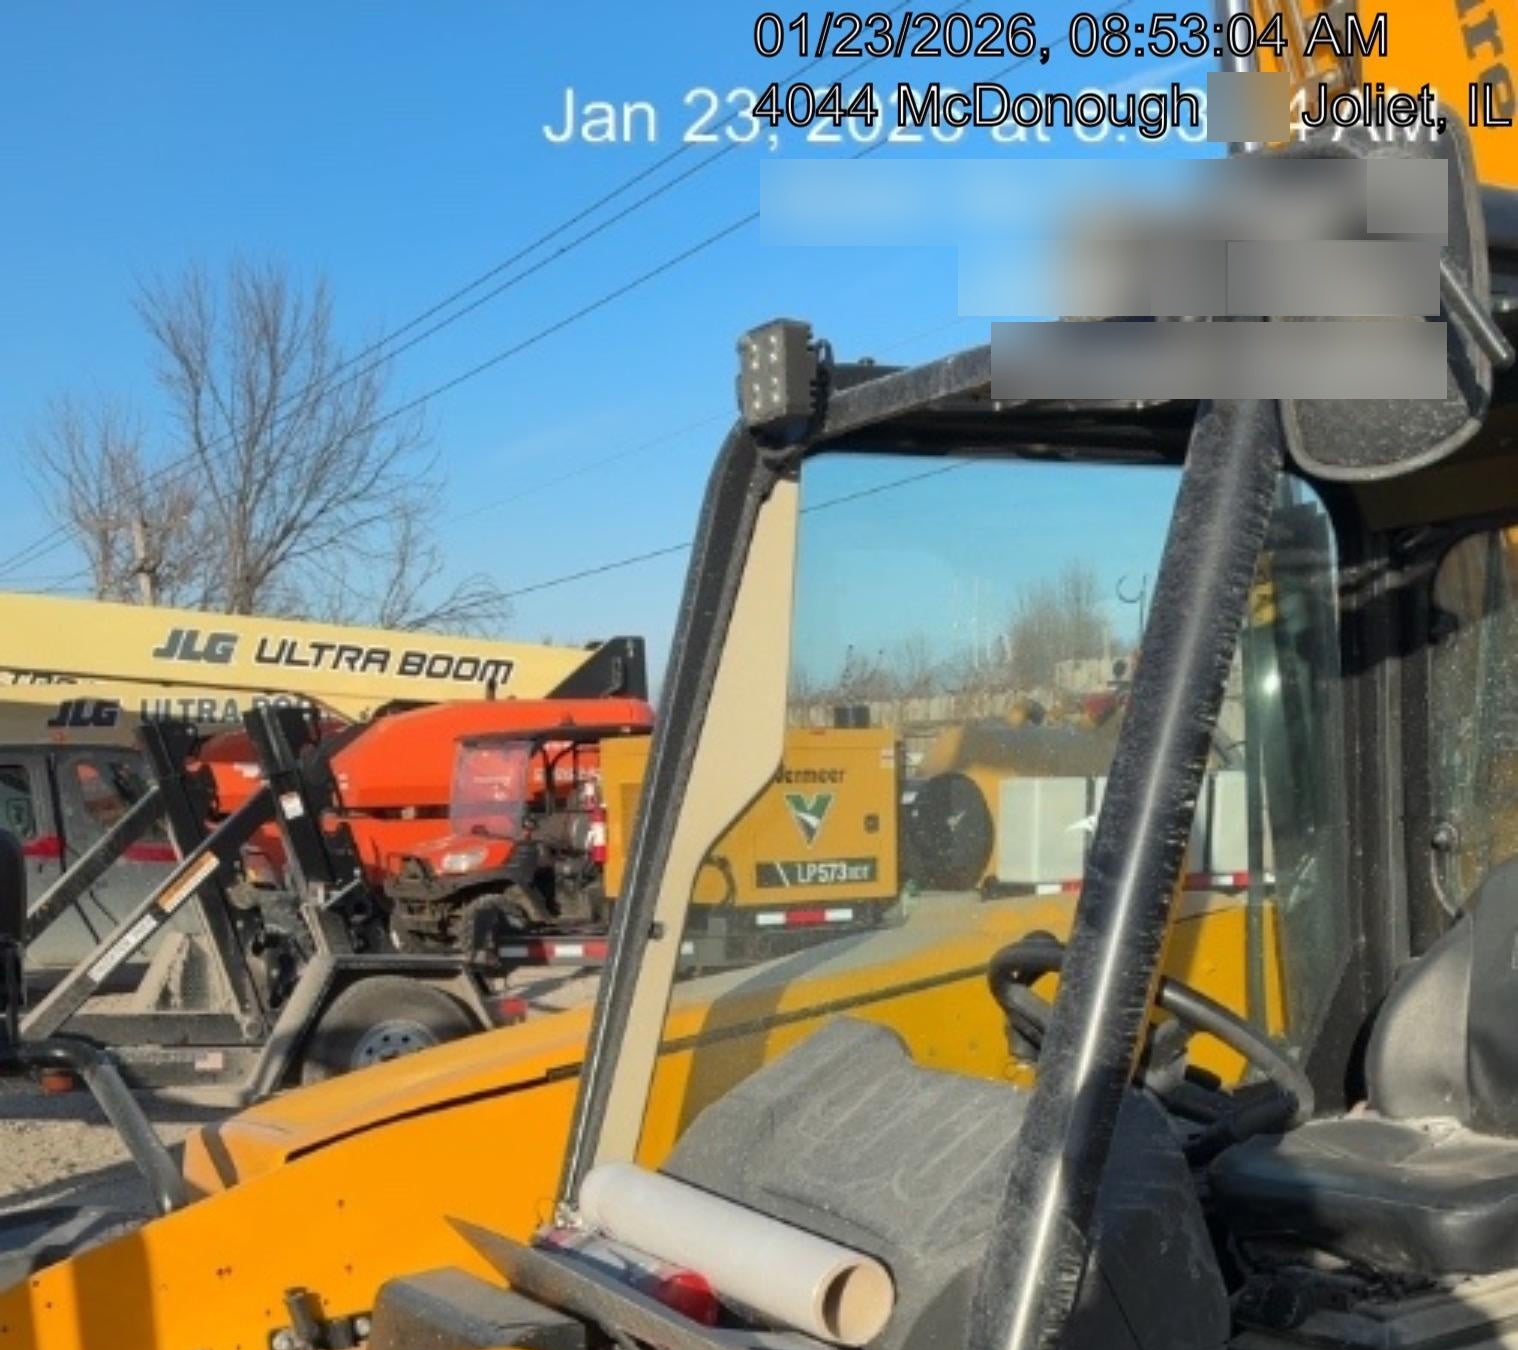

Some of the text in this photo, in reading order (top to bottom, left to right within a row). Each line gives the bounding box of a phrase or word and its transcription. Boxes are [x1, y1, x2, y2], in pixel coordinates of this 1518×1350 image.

[1454, 0, 1516, 121] re
[152, 629, 514, 685] JLG ULTRA BOOM
[47, 699, 120, 727] JLG
[140, 697, 243, 724] ULTRA
